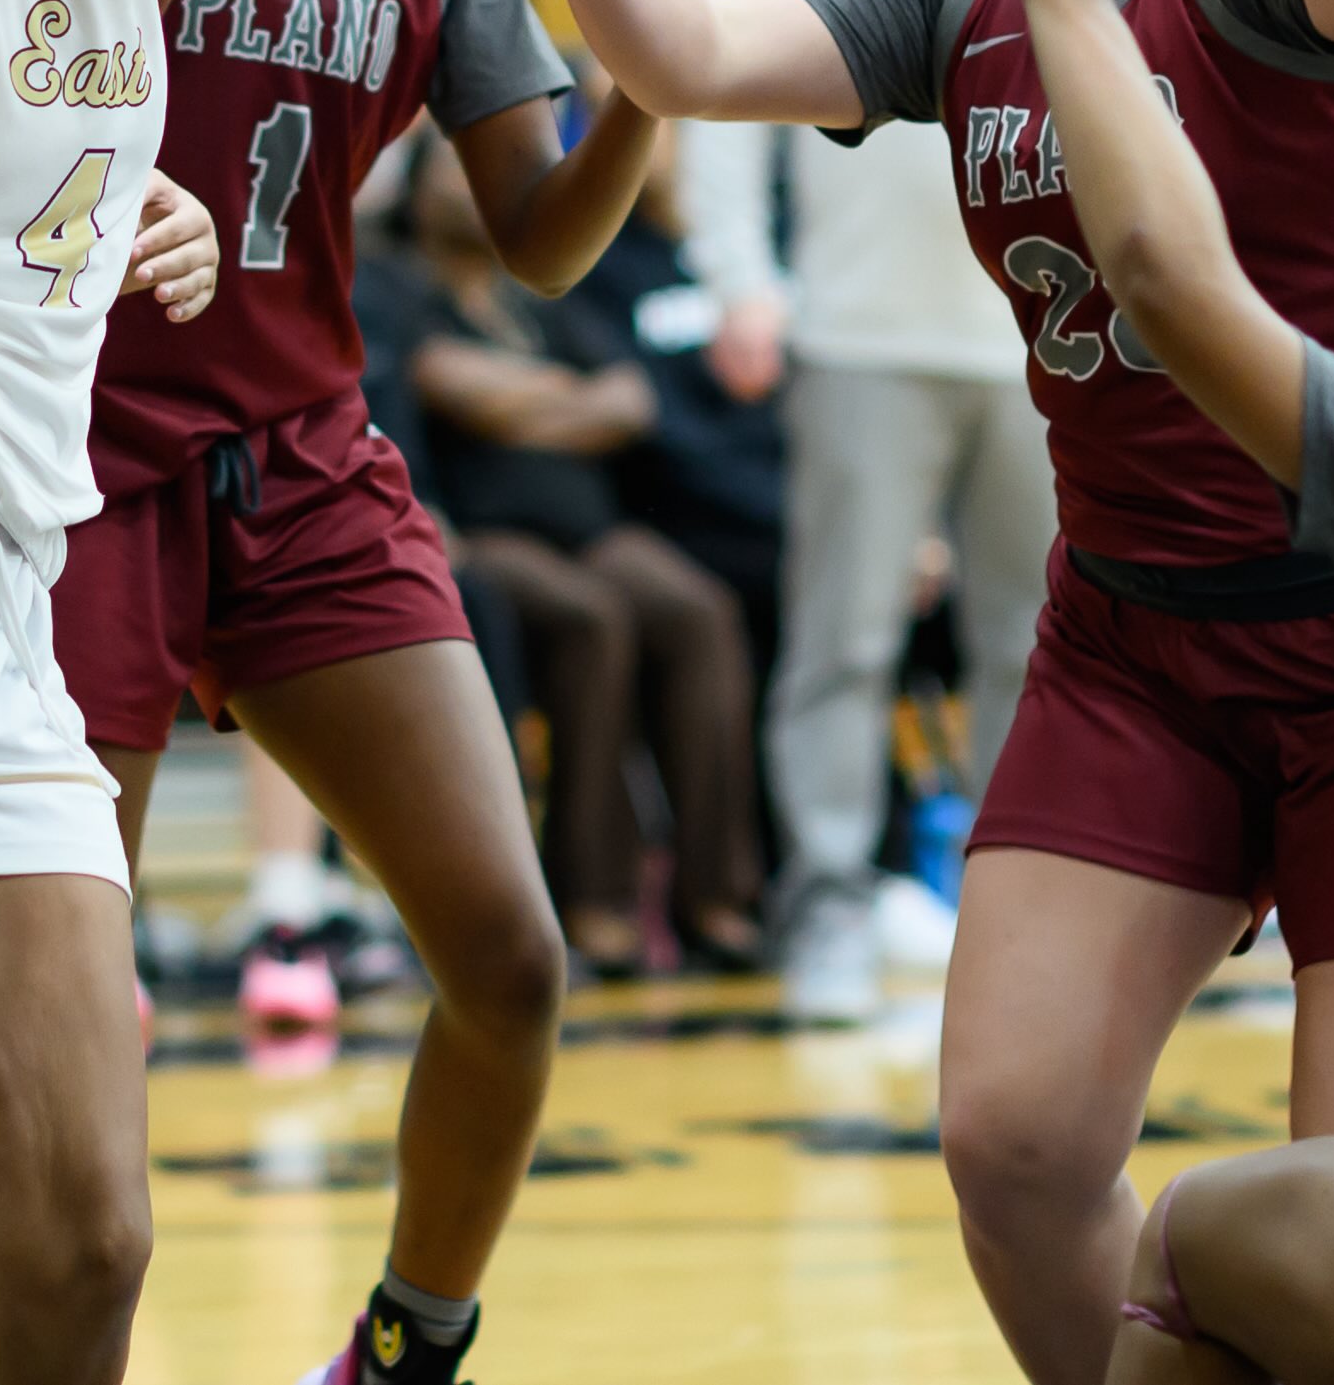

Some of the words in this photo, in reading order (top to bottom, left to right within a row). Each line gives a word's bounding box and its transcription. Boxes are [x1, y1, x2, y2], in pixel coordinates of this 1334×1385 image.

[15, 148, 116, 309] 4
[240, 102, 312, 270] 1
[1003, 235, 1170, 382] 2
